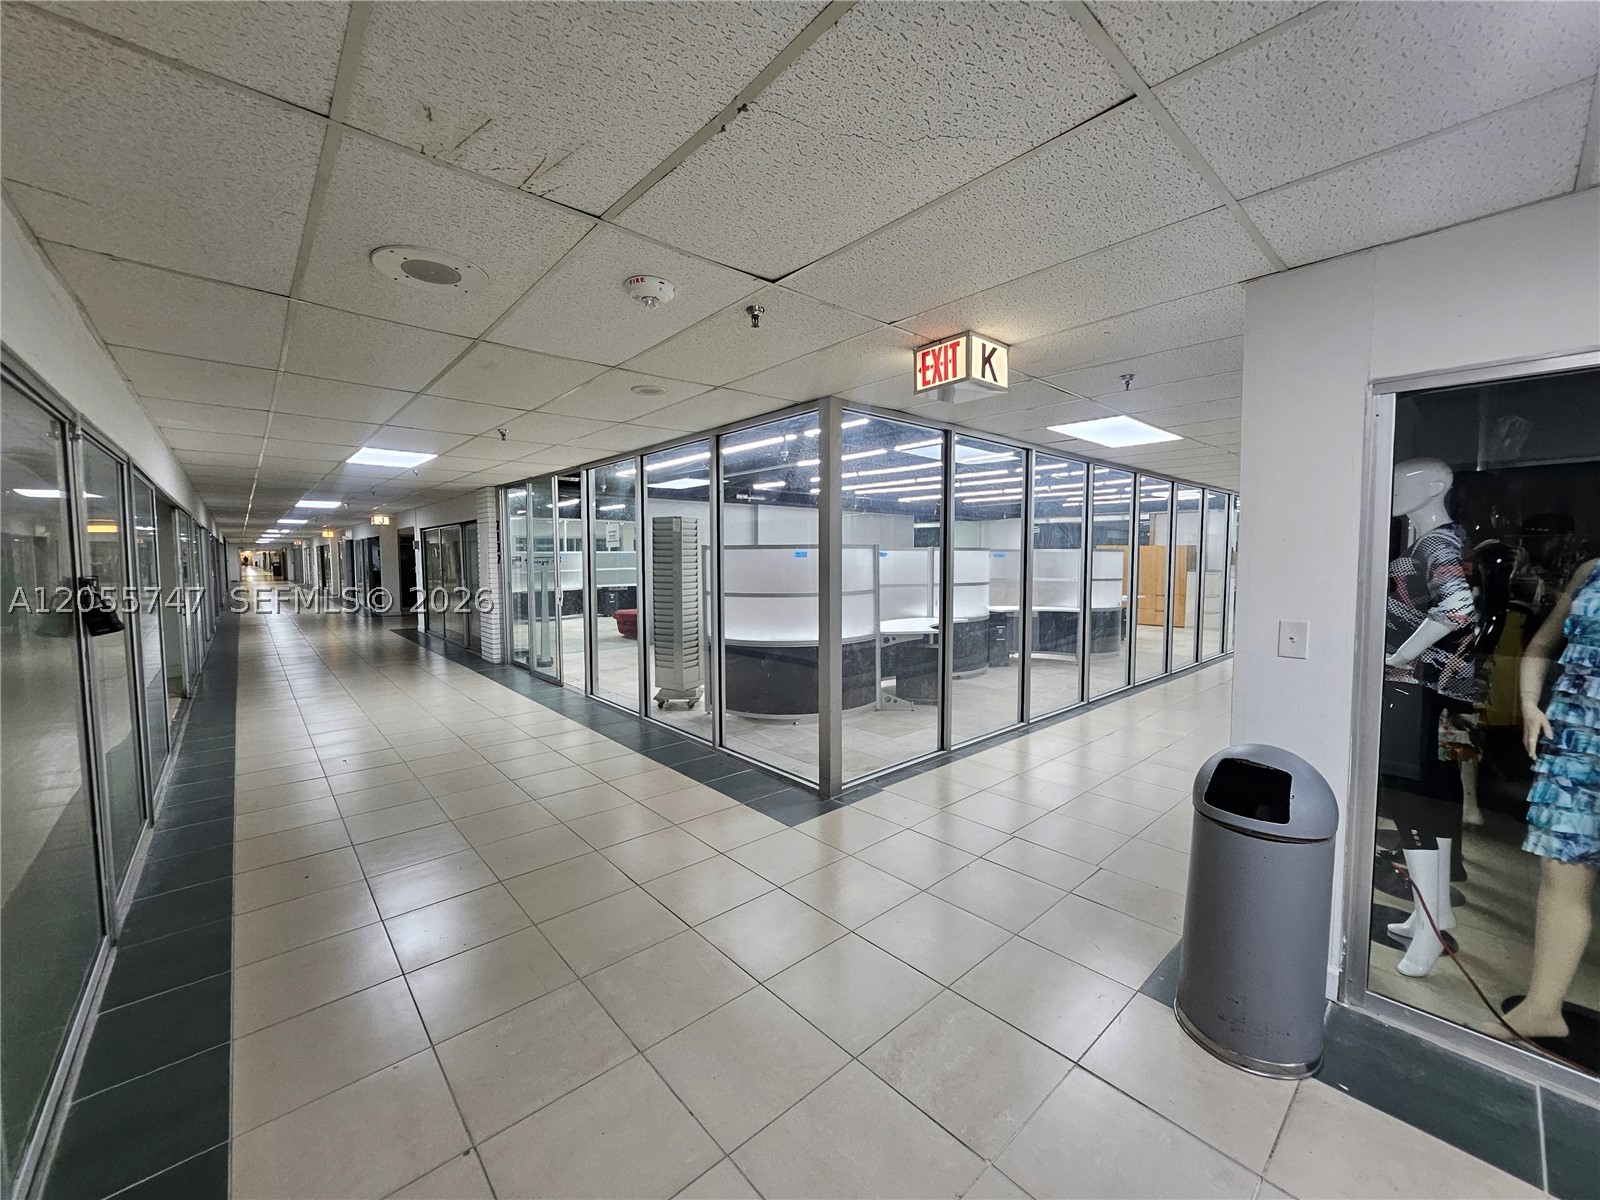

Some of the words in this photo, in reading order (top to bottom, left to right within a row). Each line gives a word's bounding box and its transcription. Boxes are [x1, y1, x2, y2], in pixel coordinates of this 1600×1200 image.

[629, 277, 646, 286] FIRE
[921, 341, 960, 387] EXIT
[981, 342, 998, 383] K
